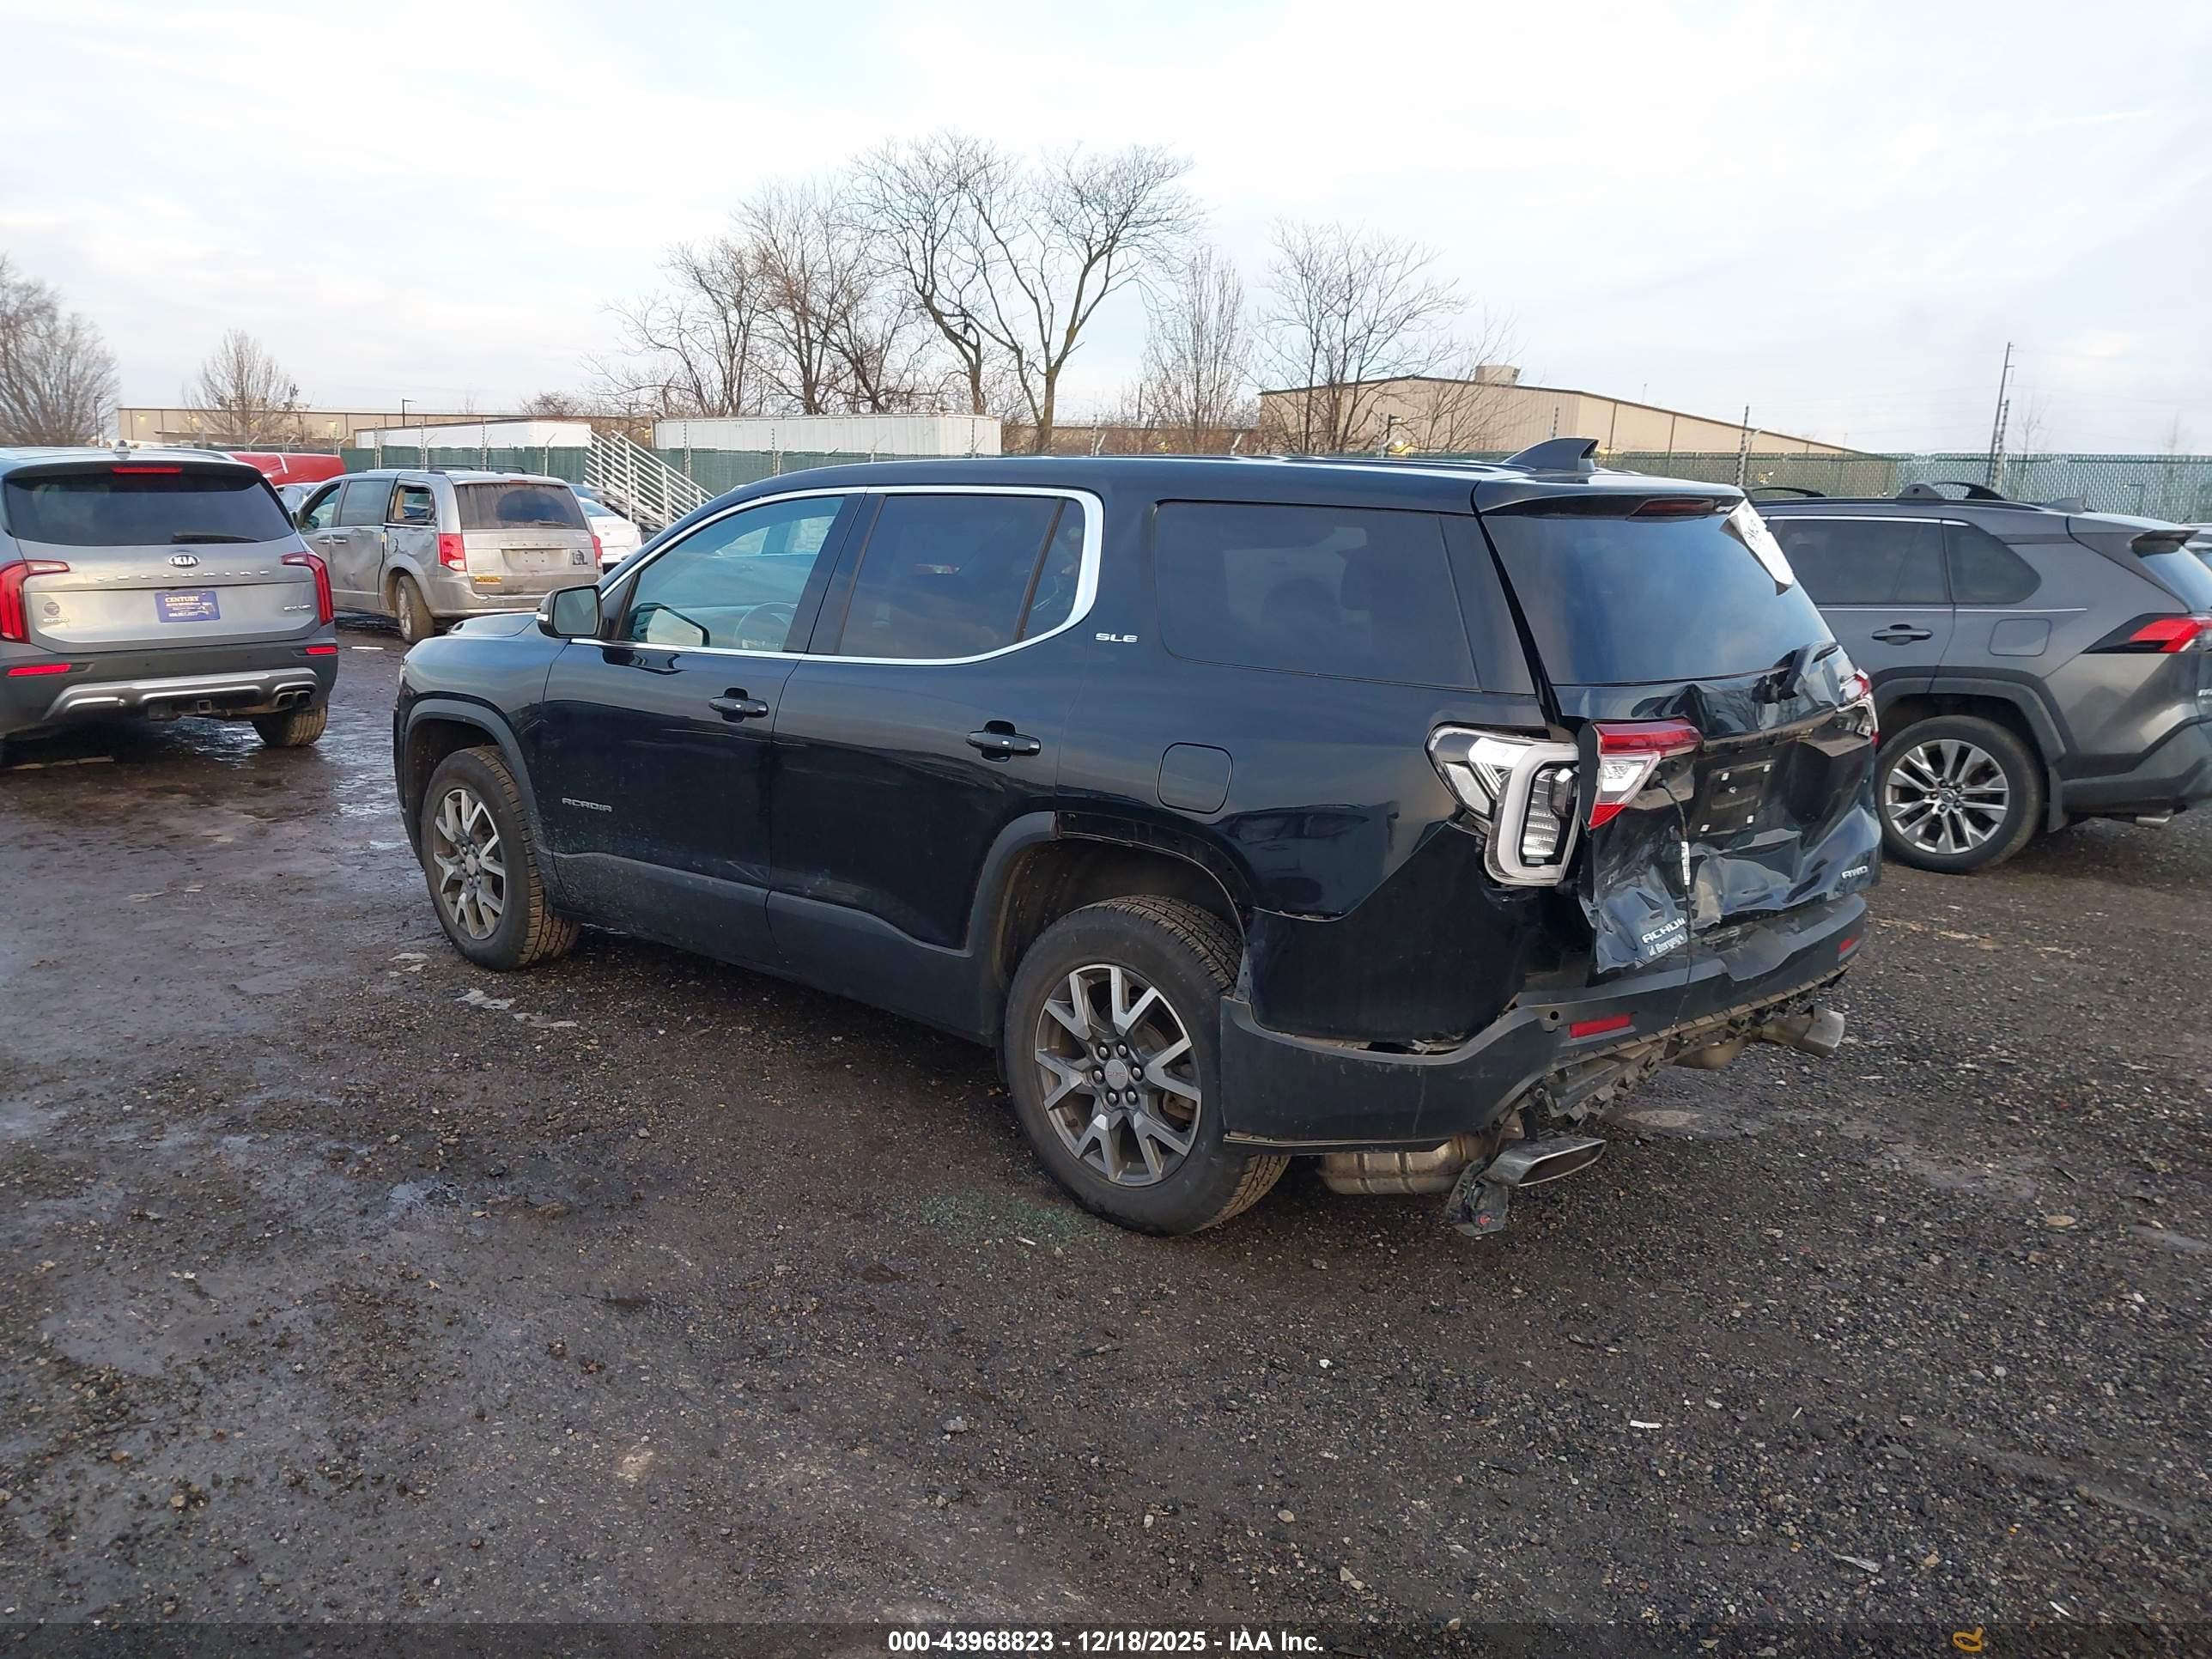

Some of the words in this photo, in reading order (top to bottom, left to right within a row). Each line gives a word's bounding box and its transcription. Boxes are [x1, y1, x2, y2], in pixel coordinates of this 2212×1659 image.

[173, 555, 198, 566] KIA
[1095, 633, 1139, 643] SLE
[562, 797, 612, 812] ACADIA
[1841, 865, 1869, 879] AWD
